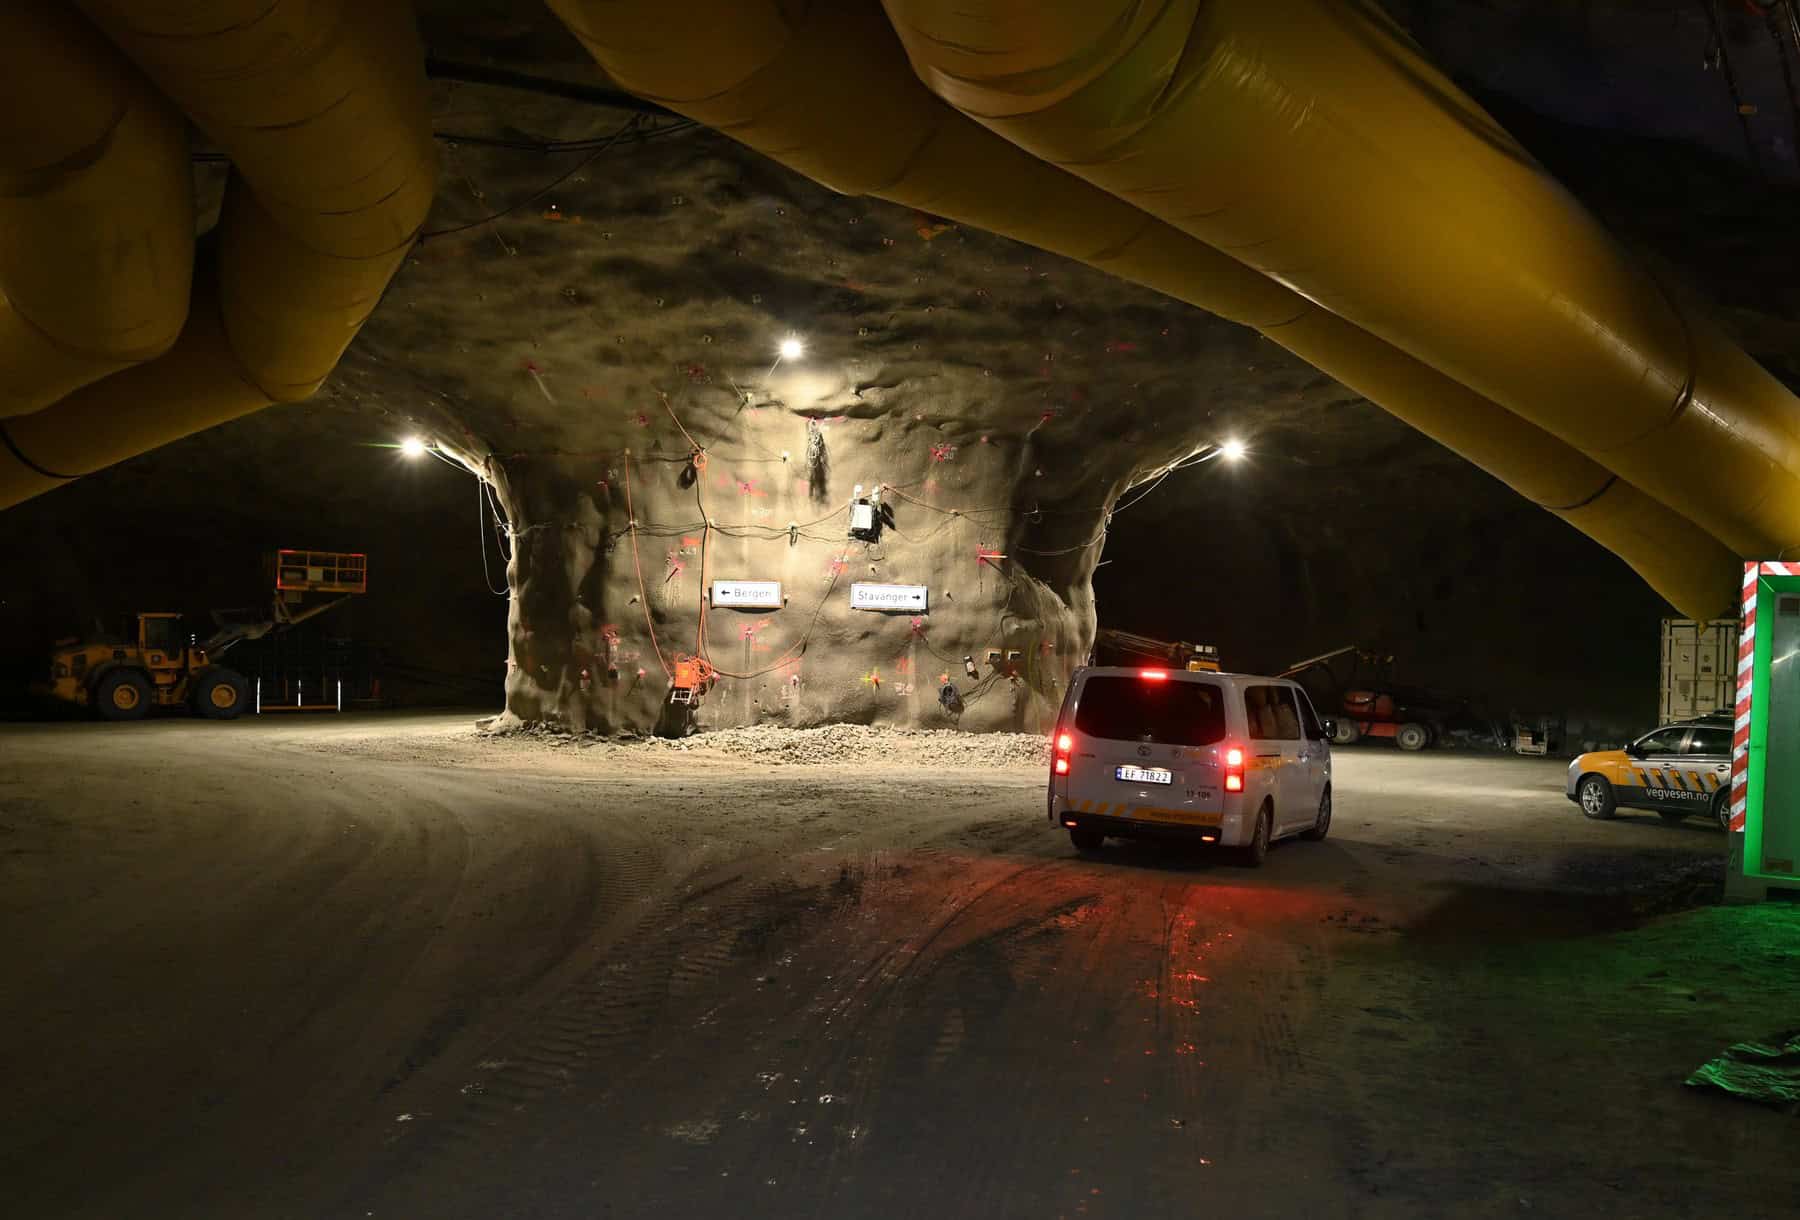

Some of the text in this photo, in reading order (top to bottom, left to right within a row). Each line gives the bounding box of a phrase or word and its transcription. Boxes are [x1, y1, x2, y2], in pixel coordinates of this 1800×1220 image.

[734, 588, 772, 599] Bergen
[858, 590, 908, 603] Stavanger
[1125, 769, 1168, 782] EF 71822
[1646, 787, 1709, 802] vegvesen.no
